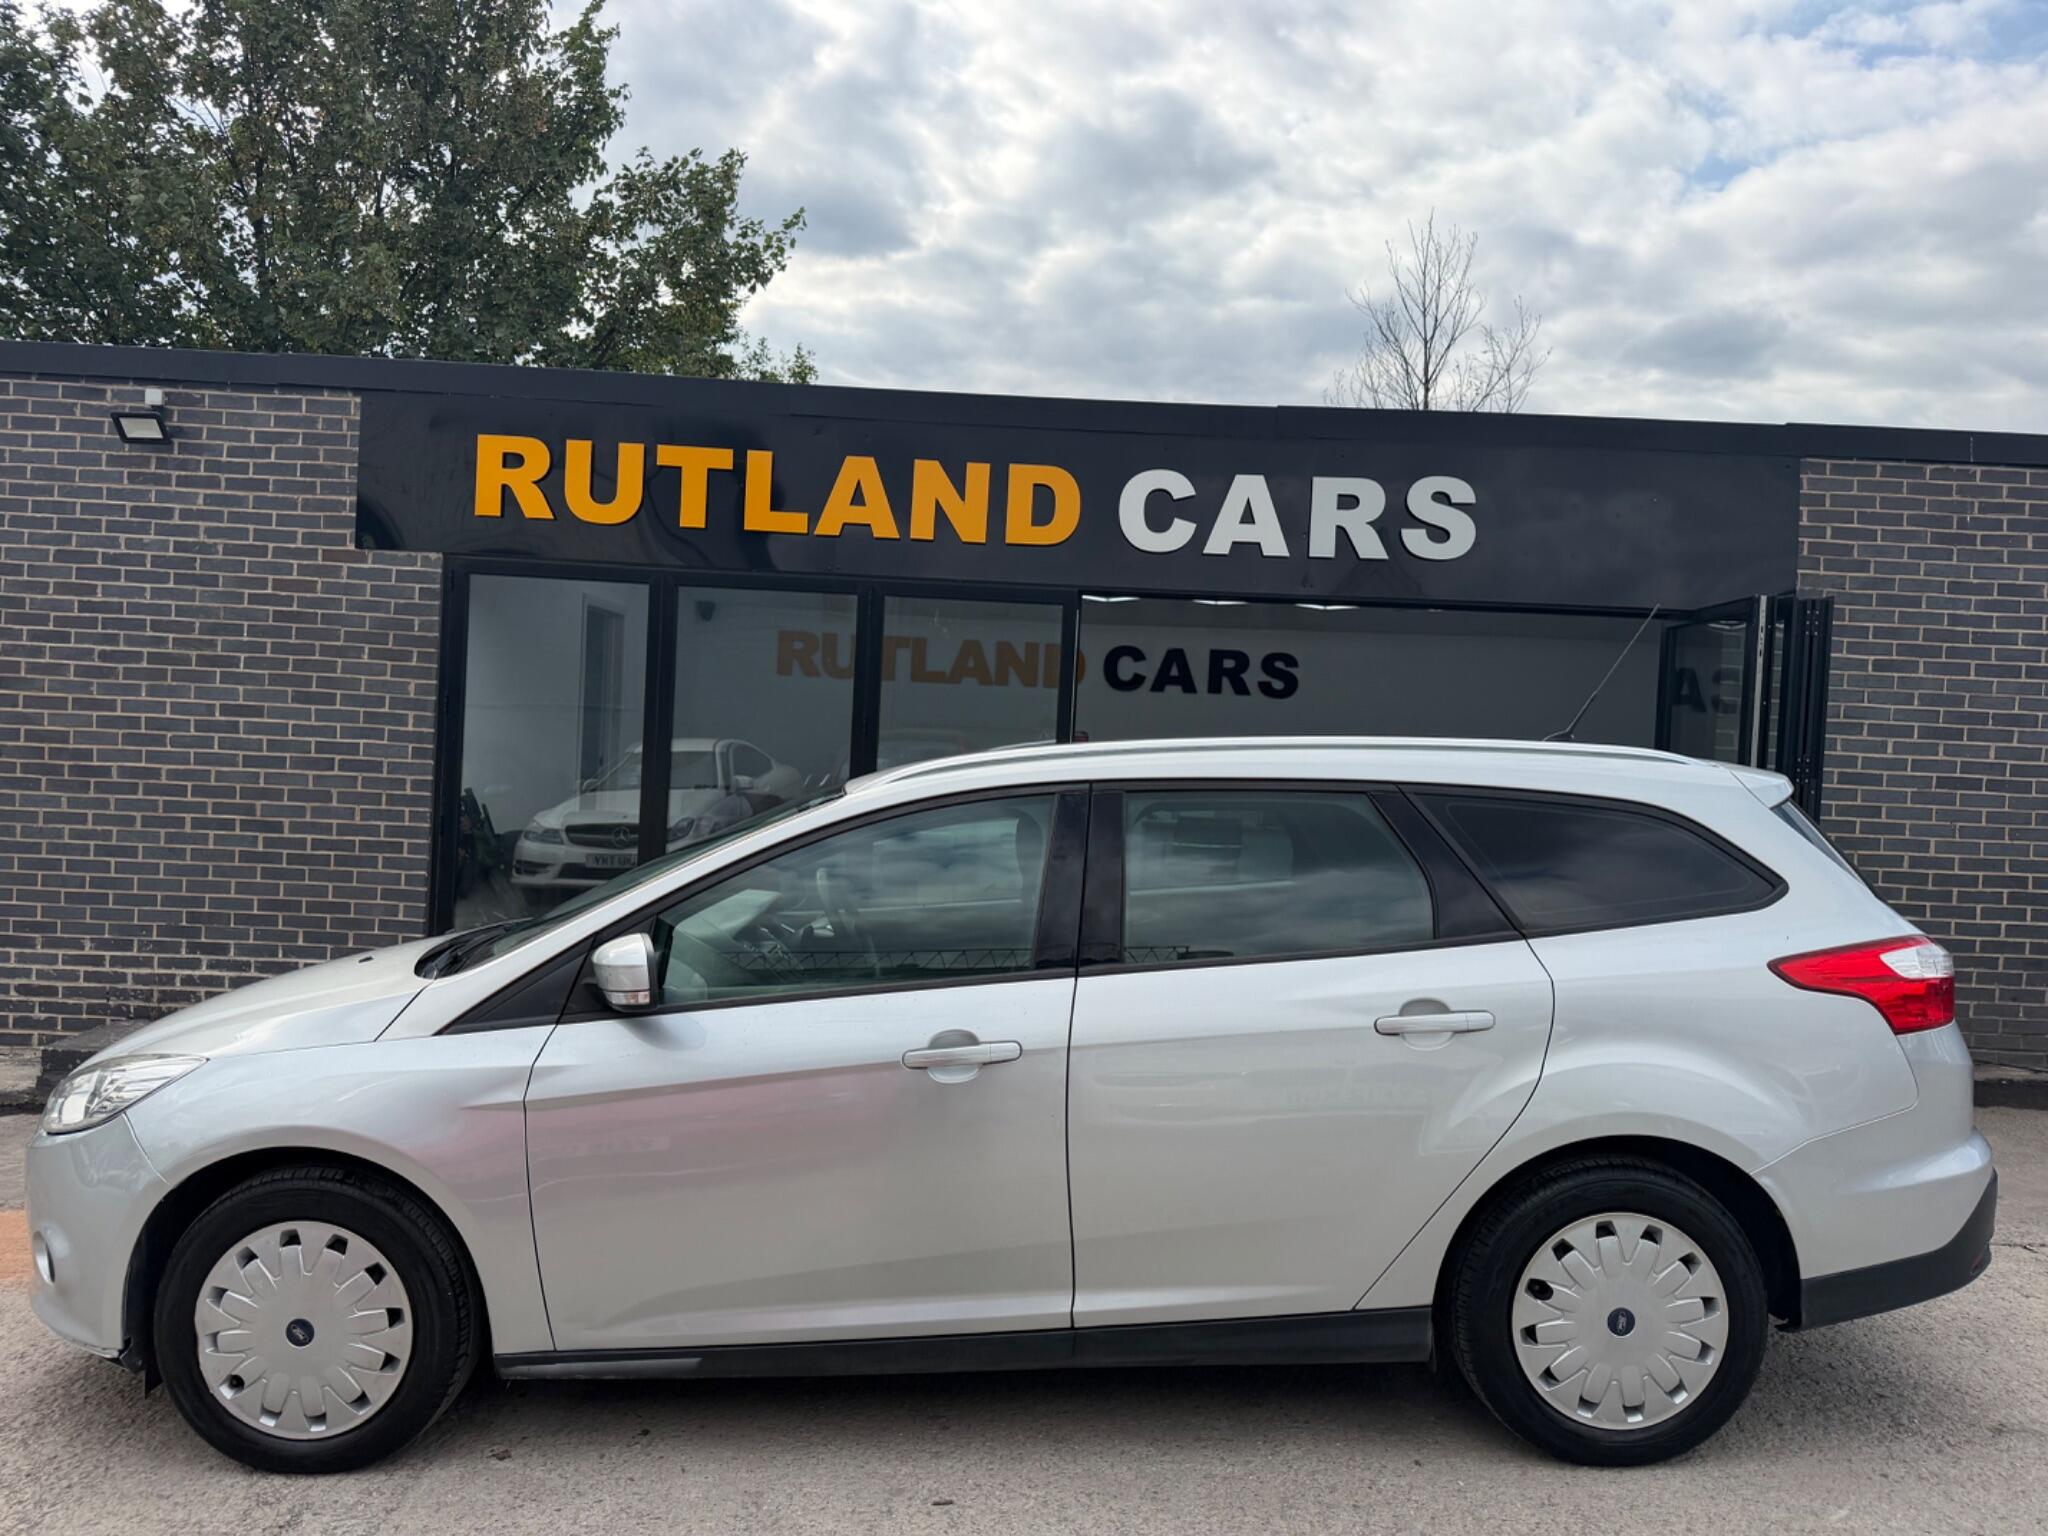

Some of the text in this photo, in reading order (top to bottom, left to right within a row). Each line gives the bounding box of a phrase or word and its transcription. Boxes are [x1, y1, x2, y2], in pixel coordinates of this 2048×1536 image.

[474, 434, 1476, 560] RUTLAND CARS
[777, 630, 1300, 699] RUTLAND CARS
